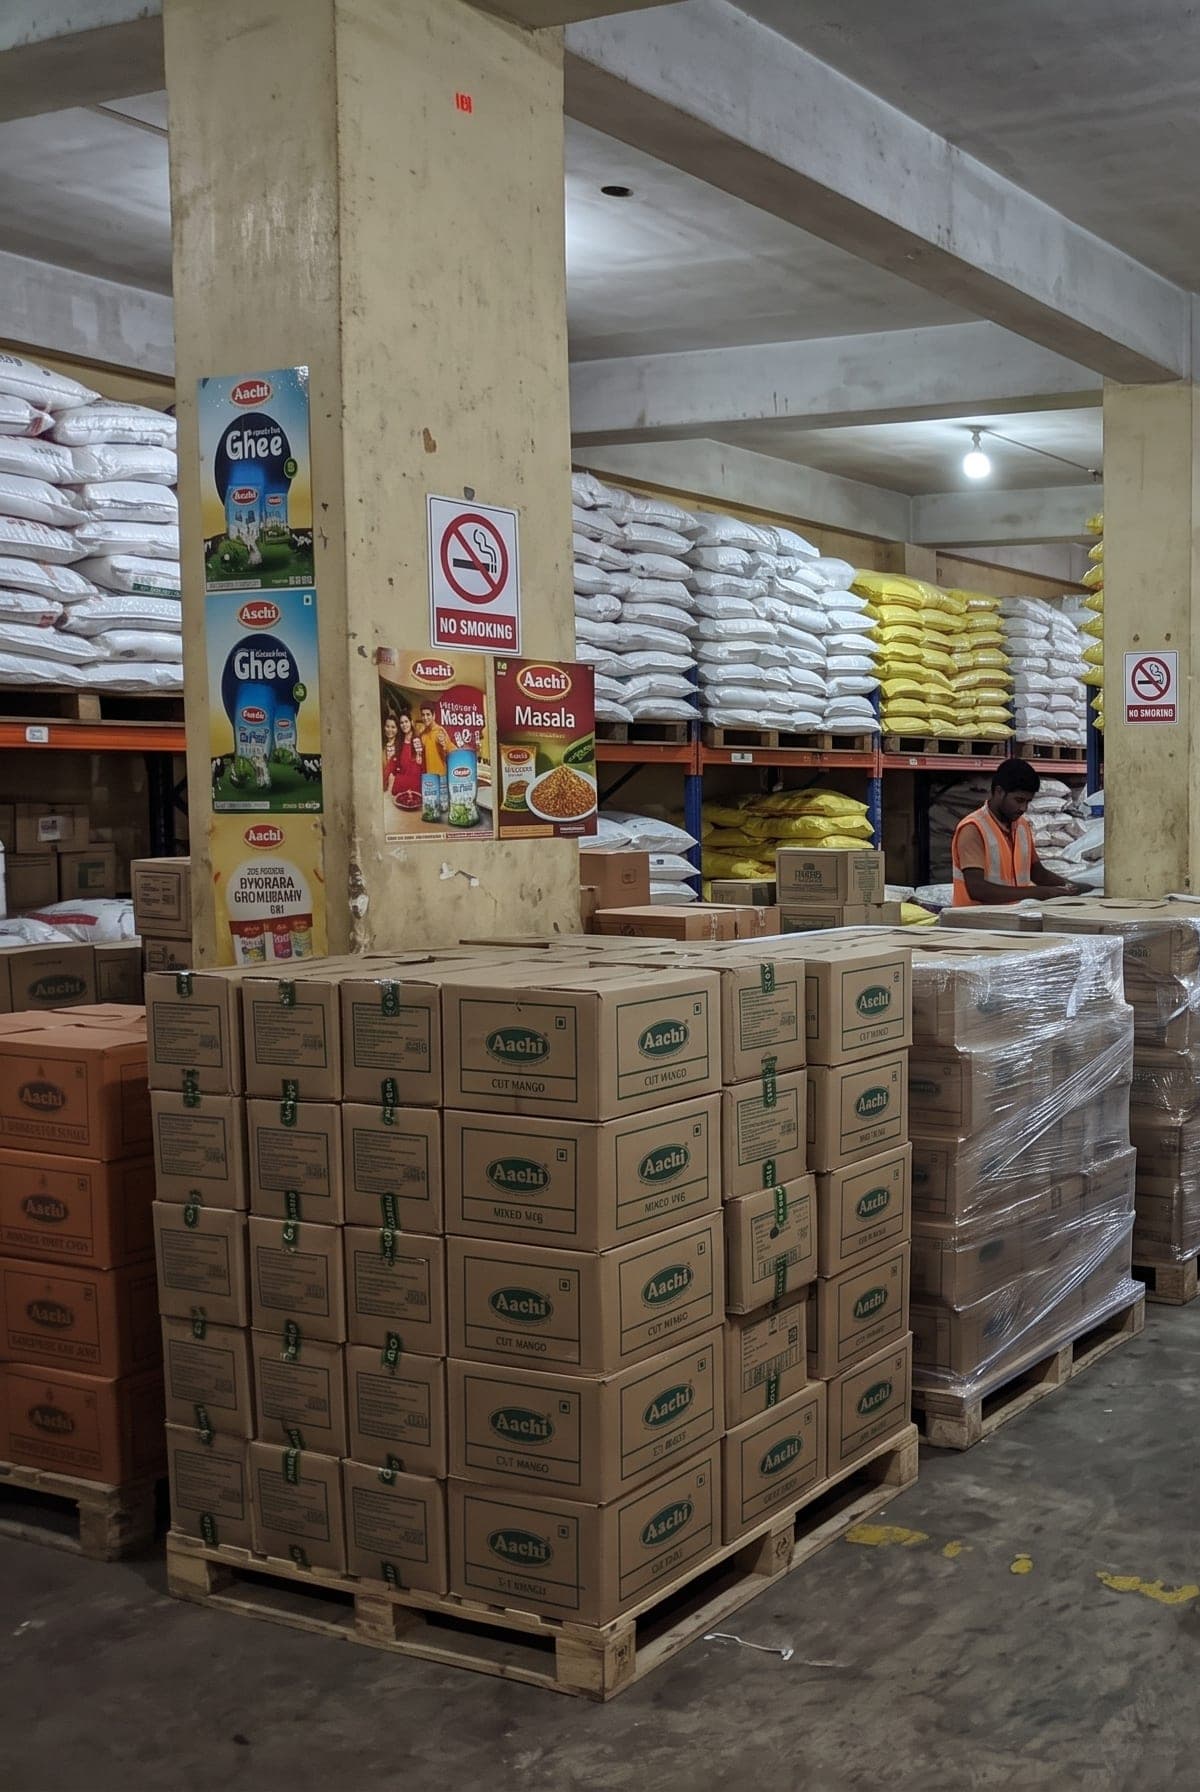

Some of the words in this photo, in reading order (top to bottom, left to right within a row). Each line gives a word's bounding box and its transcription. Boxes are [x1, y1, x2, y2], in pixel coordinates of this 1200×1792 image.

[226, 430, 282, 460] Ghee
[439, 616, 457, 635] NO
[460, 619, 513, 640] SMOKING
[233, 651, 290, 680] Ghee
[523, 671, 566, 690] Aachi
[440, 709, 484, 727] Masala
[515, 705, 576, 728] Masala
[492, 1034, 544, 1054] Aachi
[643, 1026, 685, 1050] Aachi
[491, 1078, 511, 1089] CUT
[511, 1081, 545, 1093] MANGO
[494, 1163, 545, 1185] Aachi
[647, 1269, 689, 1300] Aachi
[495, 1293, 546, 1316] Aachi
[495, 1336, 513, 1347] CUT
[515, 1339, 547, 1352] MANGO
[648, 1388, 691, 1422] Aachi
[496, 1413, 548, 1436] Aachi
[646, 1504, 688, 1543] Aachi
[494, 1535, 546, 1559] Aachi
